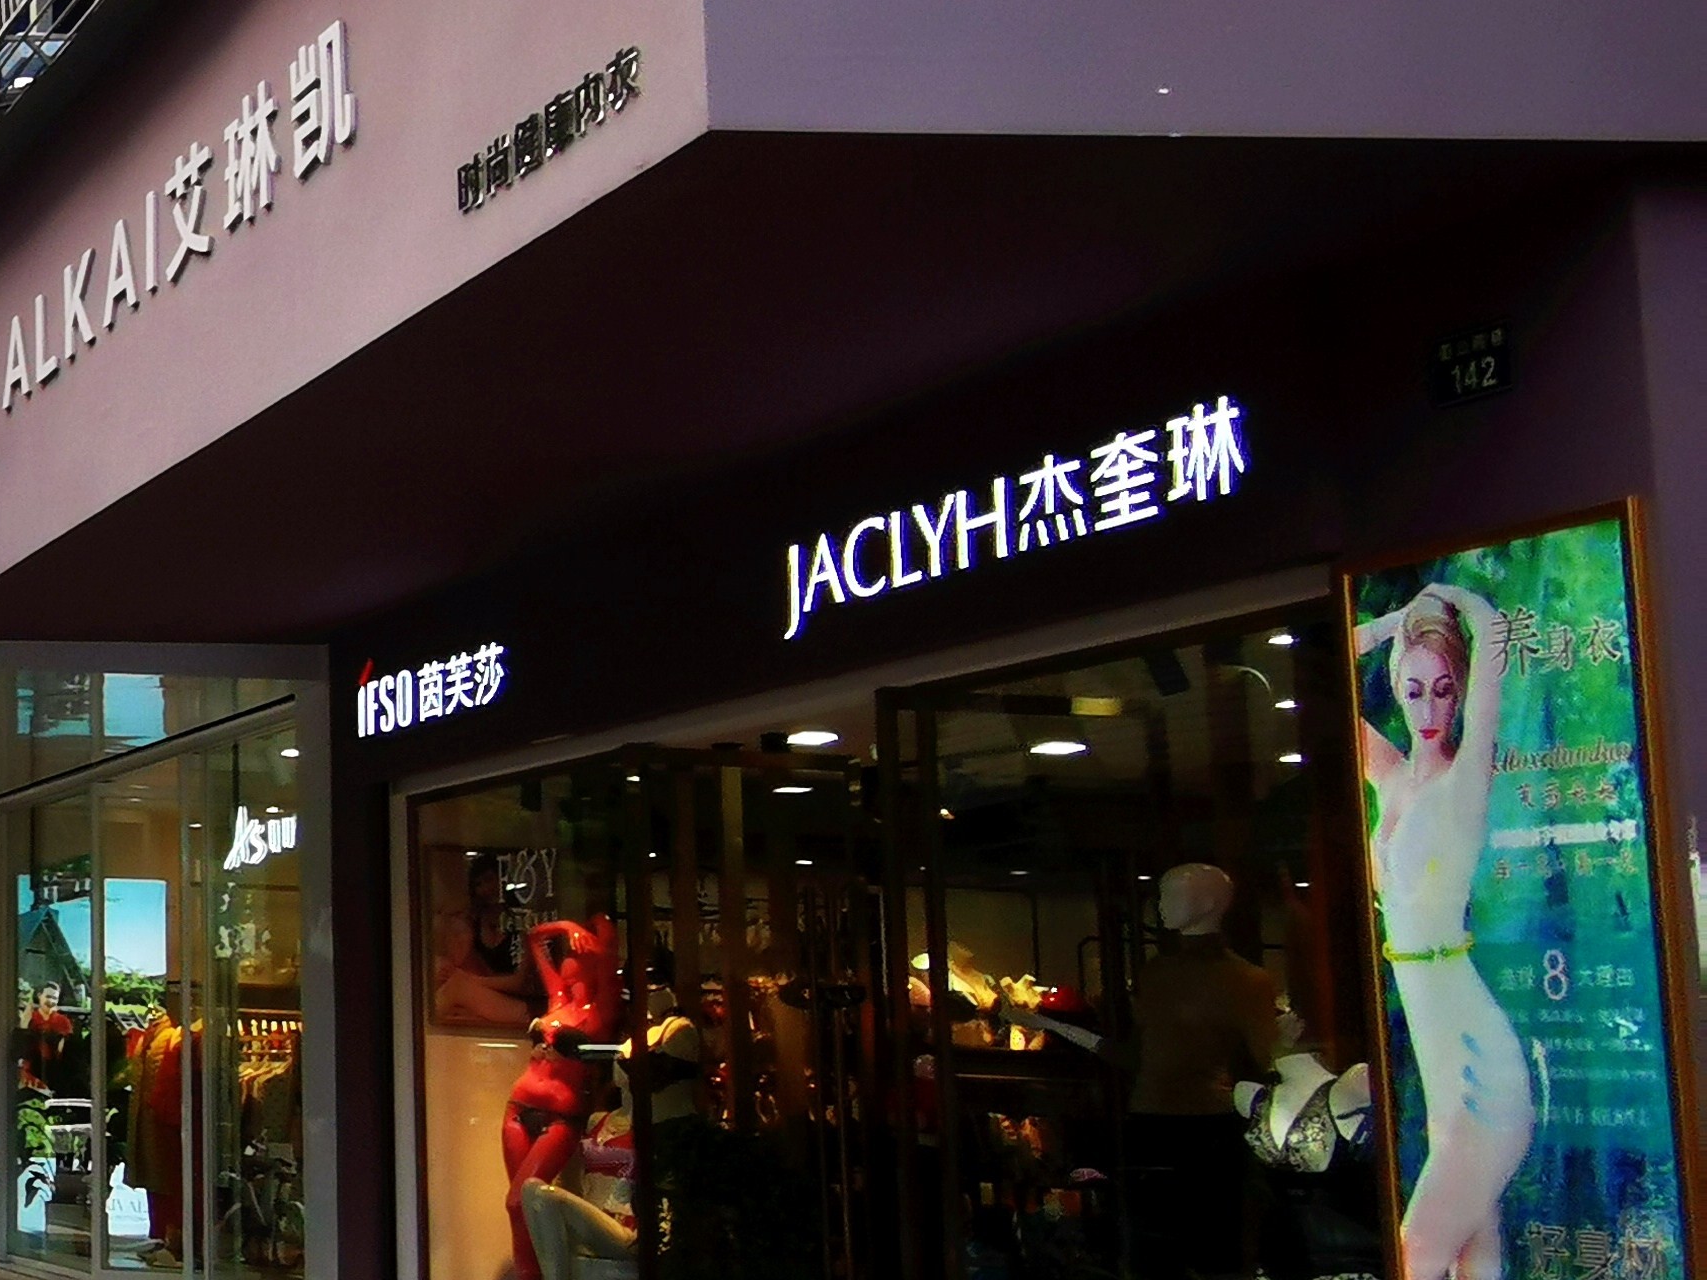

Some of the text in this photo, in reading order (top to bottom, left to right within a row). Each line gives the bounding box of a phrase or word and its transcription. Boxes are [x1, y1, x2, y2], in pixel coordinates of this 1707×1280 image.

[455, 45, 643, 216] 时尚健康内衣
[0, 18, 357, 412] ALKAI艾琳凯
[1450, 355, 1499, 394] 142
[1489, 604, 1623, 678] 养身衣
[417, 642, 507, 724] 茵芙莎
